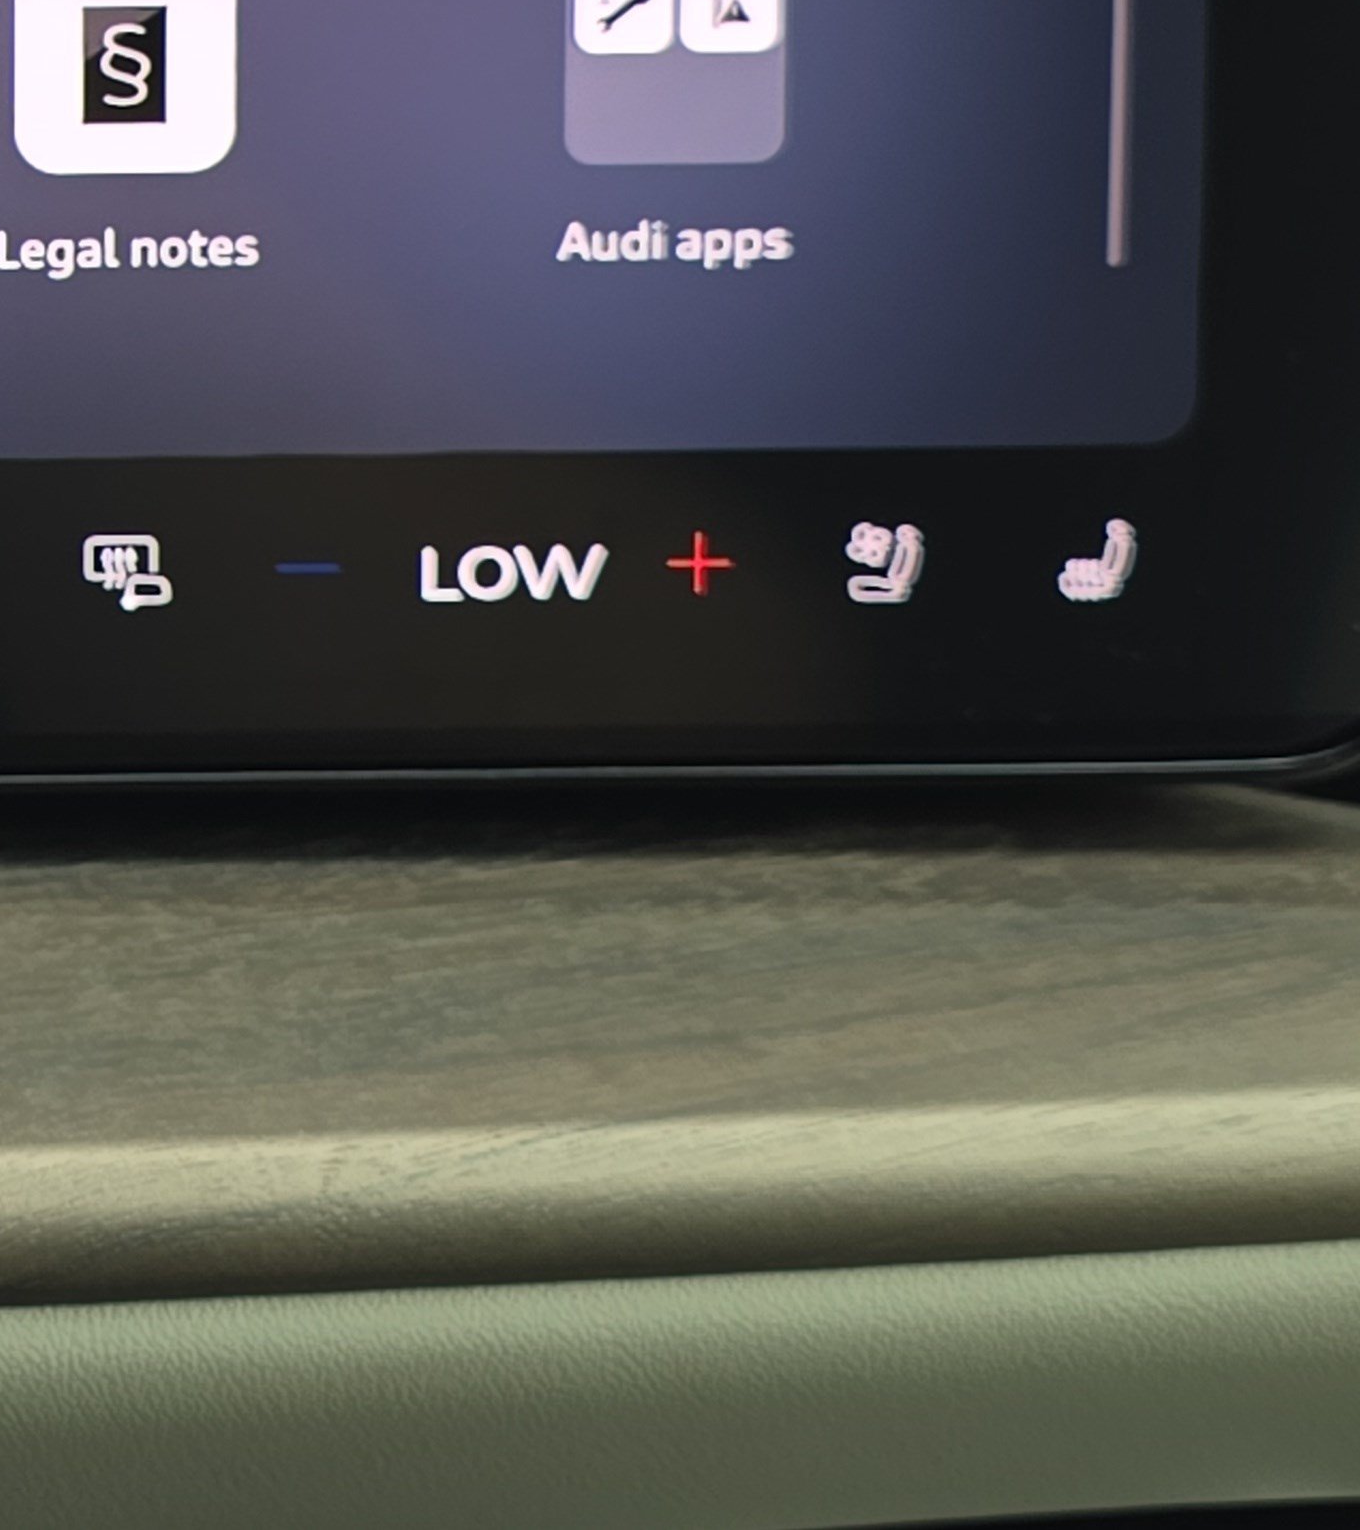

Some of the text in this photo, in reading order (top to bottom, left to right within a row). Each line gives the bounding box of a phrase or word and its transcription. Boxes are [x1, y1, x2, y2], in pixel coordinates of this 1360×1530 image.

[130, 228, 261, 269] notes
[555, 218, 795, 270] Audi apps
[419, 543, 610, 603] LOW
